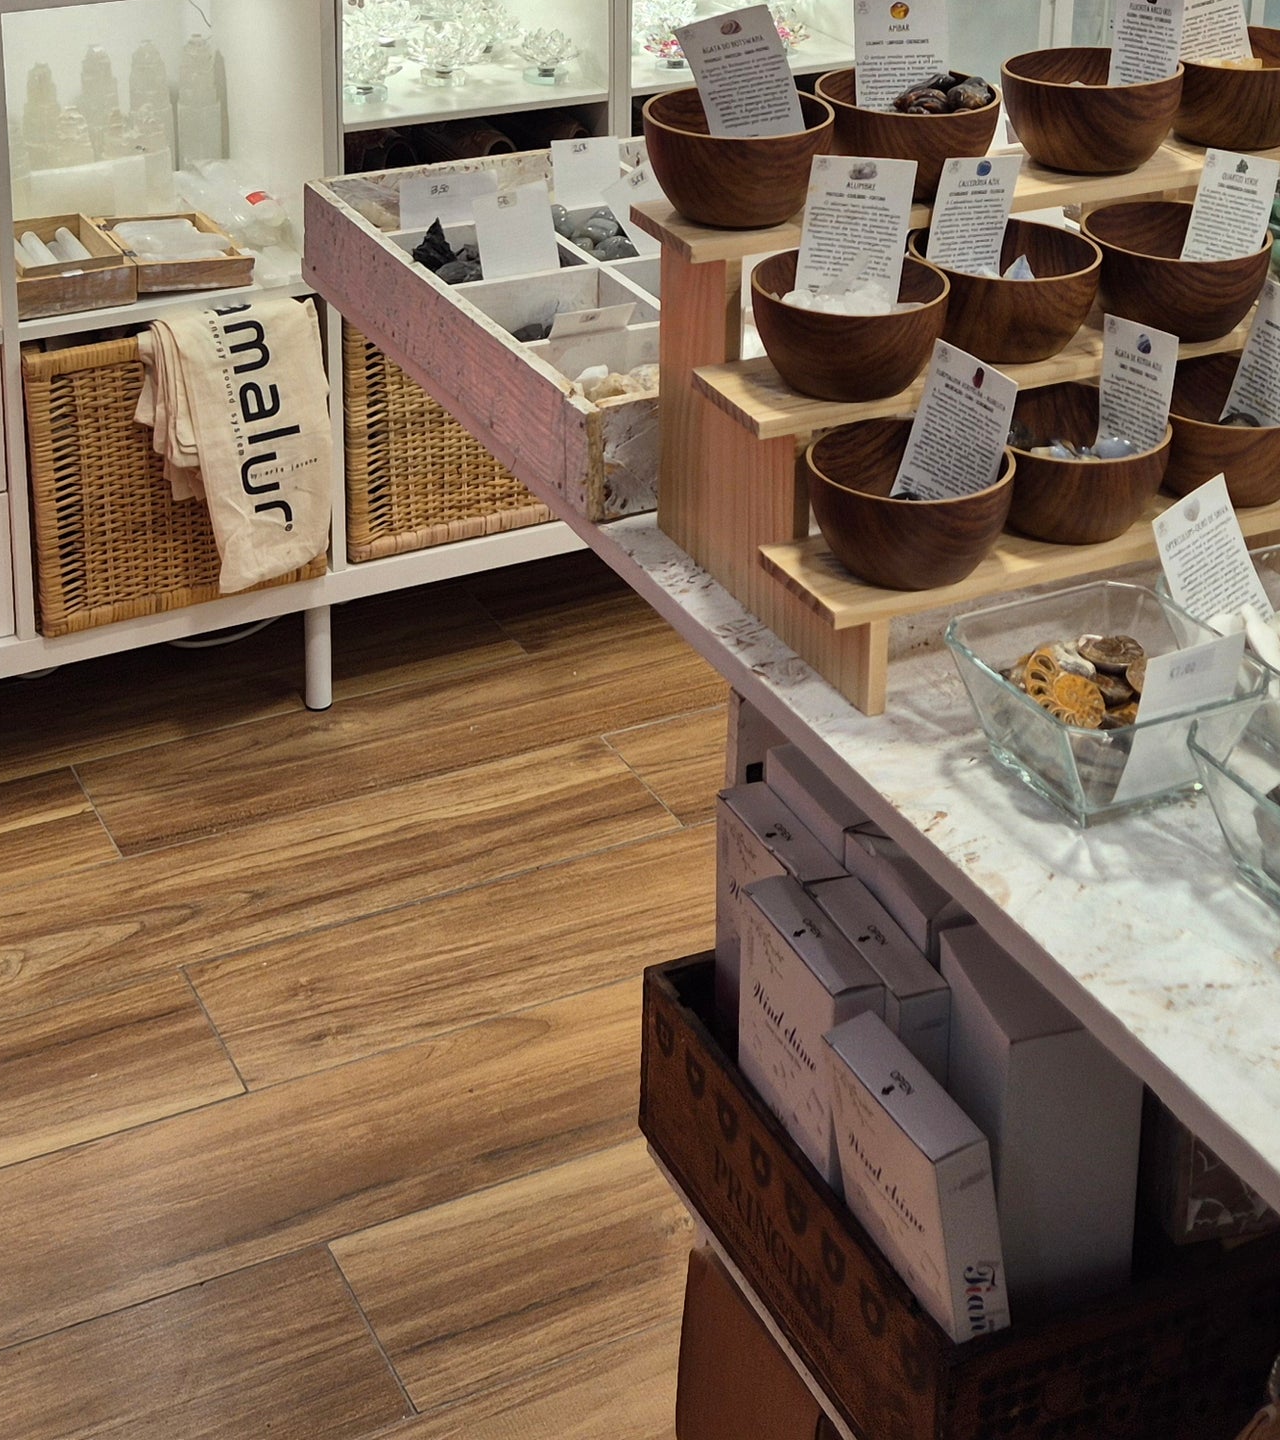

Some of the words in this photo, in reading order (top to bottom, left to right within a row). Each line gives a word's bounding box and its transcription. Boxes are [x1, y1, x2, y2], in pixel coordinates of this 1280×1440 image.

[222, 367, 237, 404] sound
[214, 303, 302, 523] malur
[753, 980, 785, 1028] Wind
[784, 1027, 817, 1072] chime
[890, 1069, 915, 1096] OPEN
[848, 1131, 884, 1182] Wind
